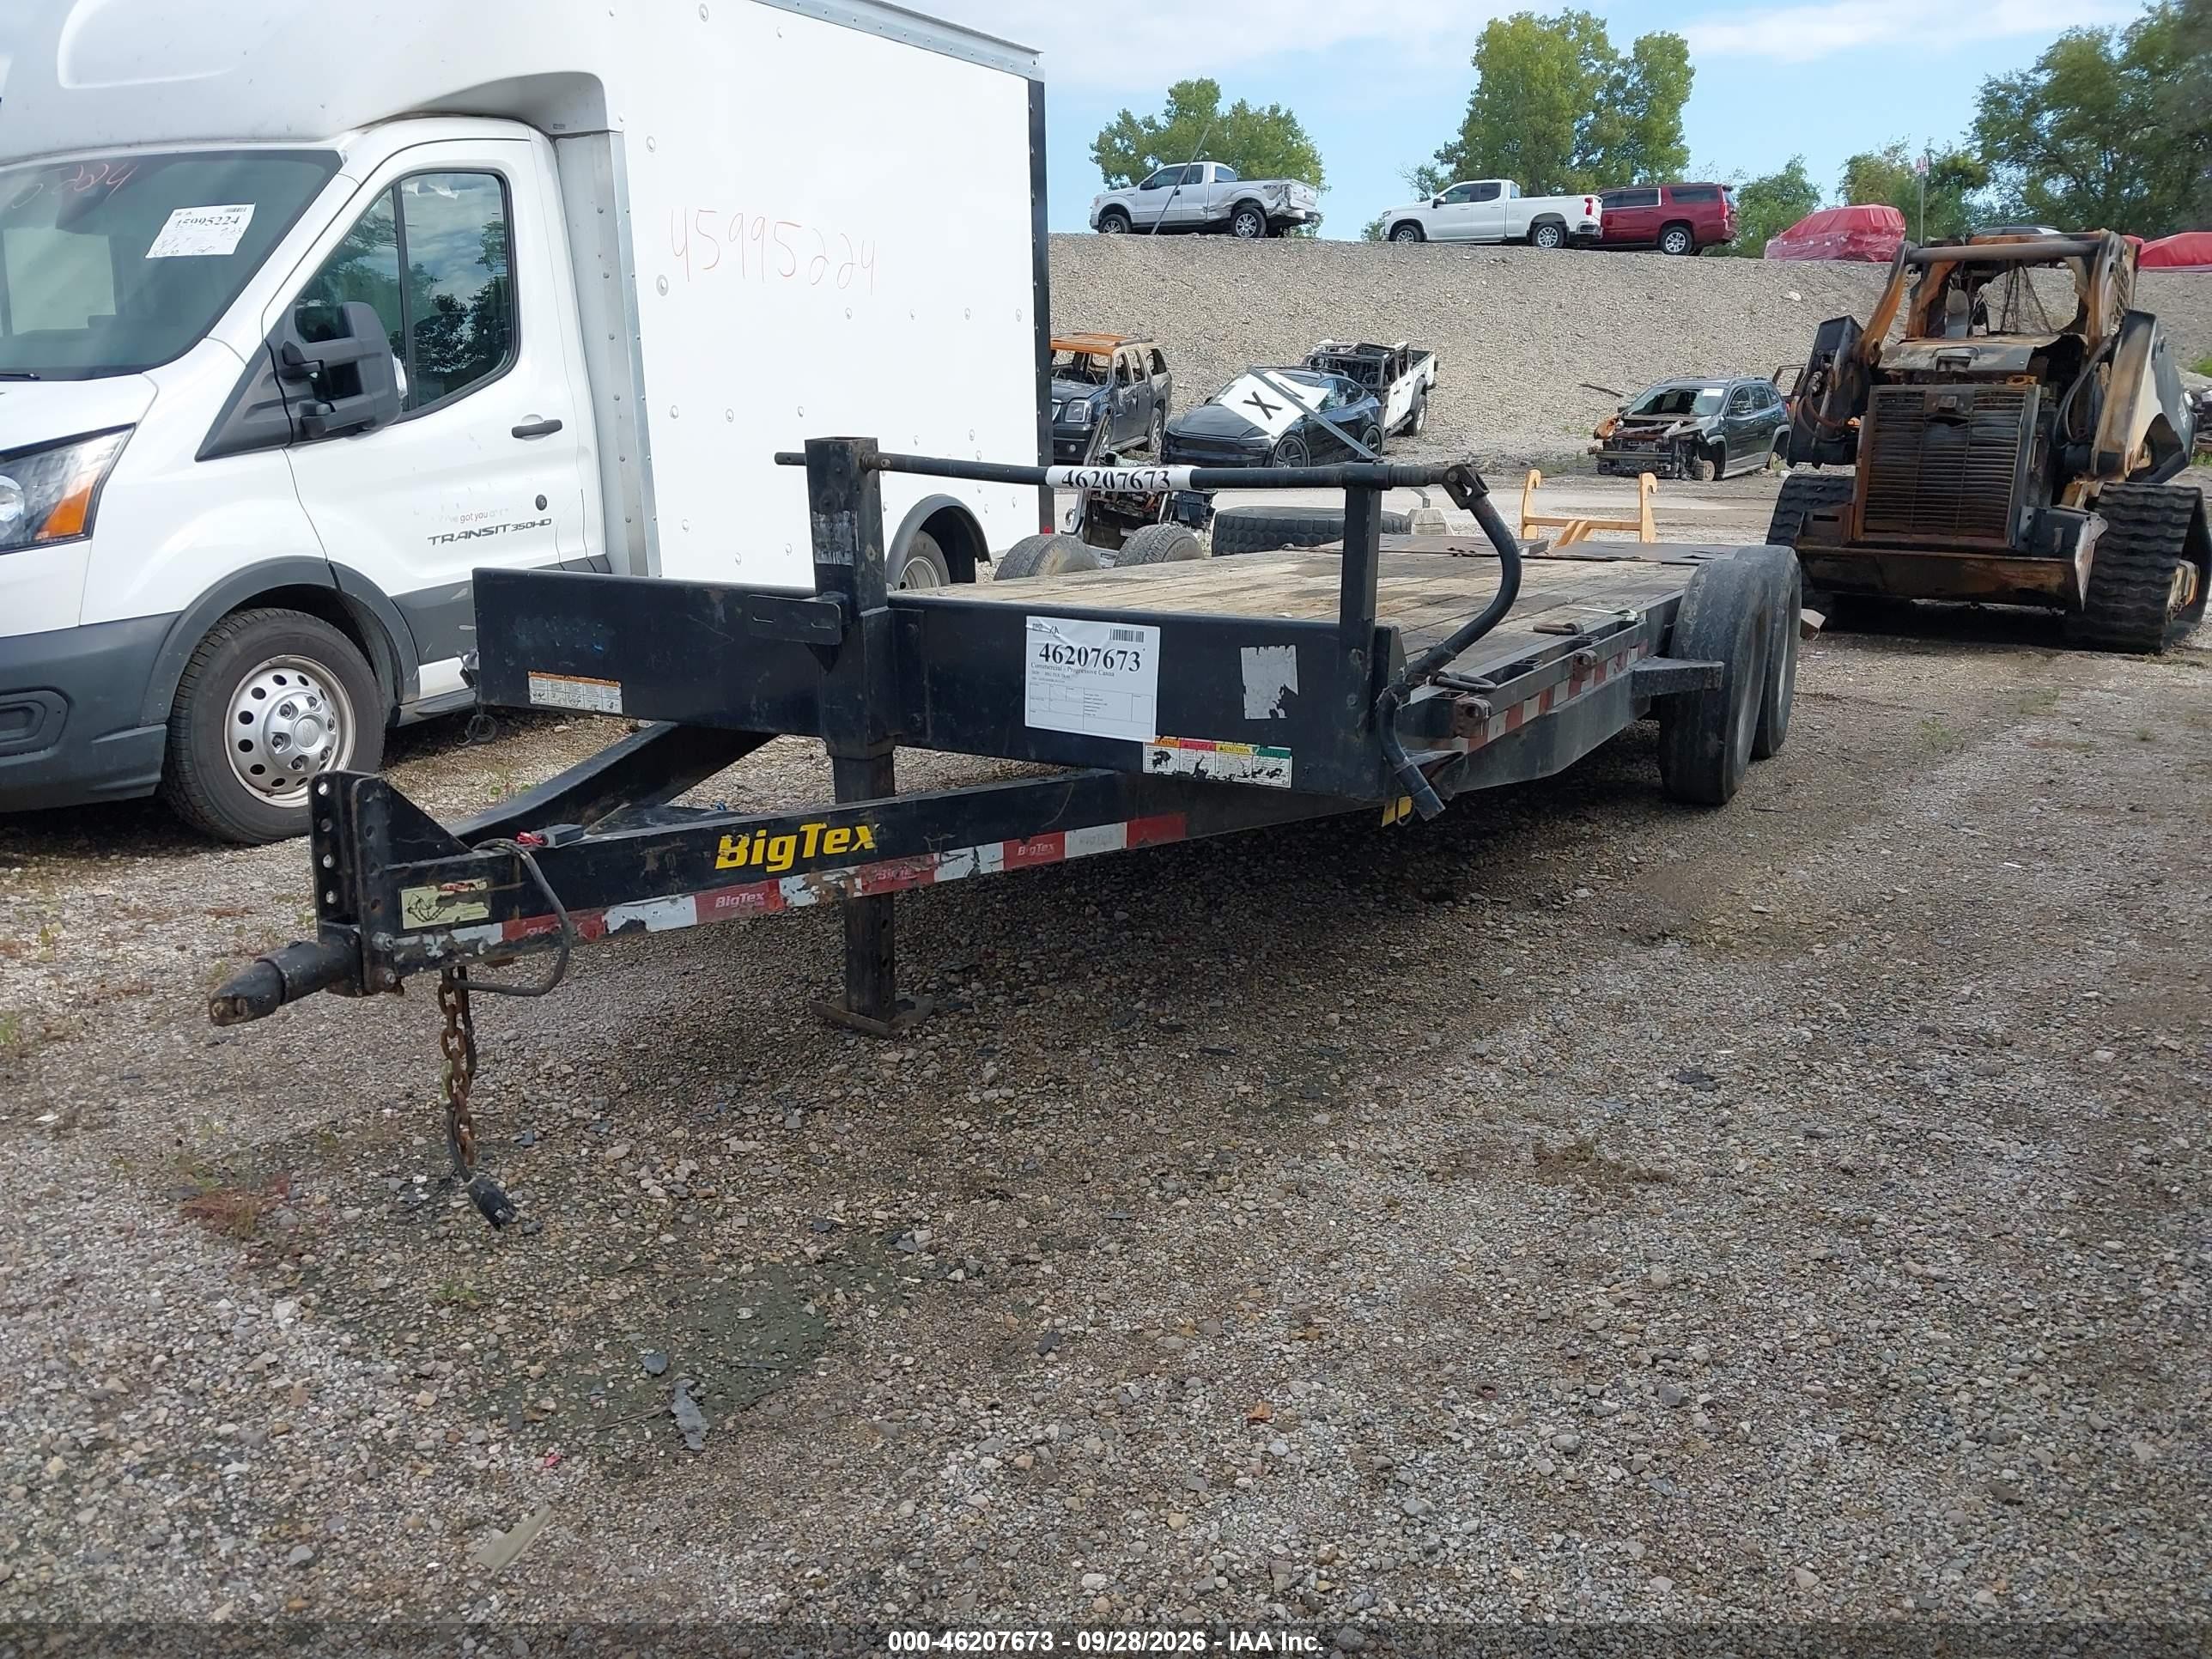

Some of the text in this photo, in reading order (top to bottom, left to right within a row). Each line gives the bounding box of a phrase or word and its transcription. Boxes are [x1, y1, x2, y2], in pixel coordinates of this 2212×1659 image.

[671, 206, 876, 296] 45995224
[1061, 469, 1170, 490] 46207673
[460, 513, 473, 524] got
[474, 511, 489, 522] you
[428, 518, 552, 545] TRANSIT 350HD
[1039, 642, 1141, 672] 46207673
[1030, 662, 1062, 672] Commercial
[1066, 666, 1097, 675] Progressive
[715, 822, 880, 872] BigTex
[1018, 843, 1055, 856] BigTex
[715, 892, 764, 908] BigTex
